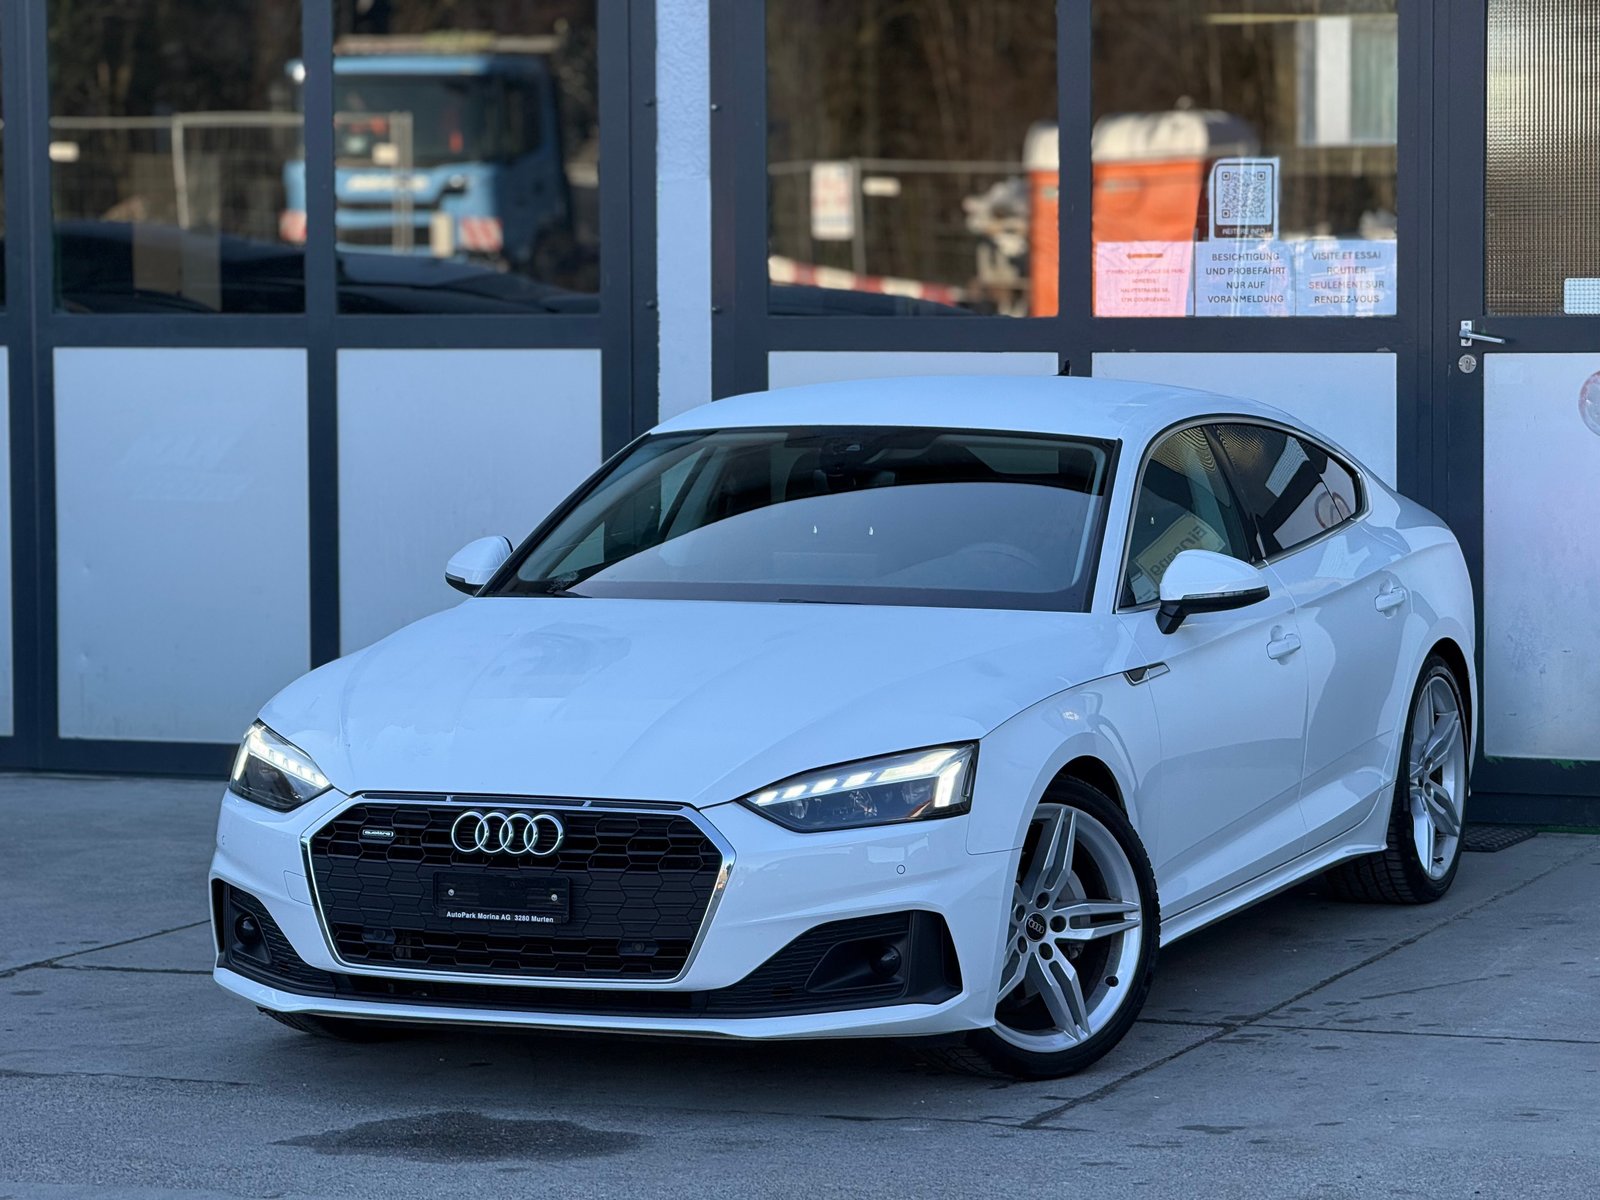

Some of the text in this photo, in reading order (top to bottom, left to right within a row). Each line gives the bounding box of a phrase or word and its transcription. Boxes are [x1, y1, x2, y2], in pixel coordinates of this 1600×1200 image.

[1212, 253, 1280, 261] BESICHTIGUNG
[1312, 251, 1381, 260] VISITE ET ESSAI
[1206, 267, 1286, 275] UND PROBEFAHRT
[1326, 266, 1367, 274] ROUTIER
[1226, 281, 1265, 289] NUR AUF
[1309, 281, 1363, 289] SEULEMENT
[1207, 295, 1284, 303] VORANMELDUNG
[1314, 295, 1380, 303] RENDEZ-VOUS
[446, 911, 554, 923] AutoPark Morina AG 3280 Murten
